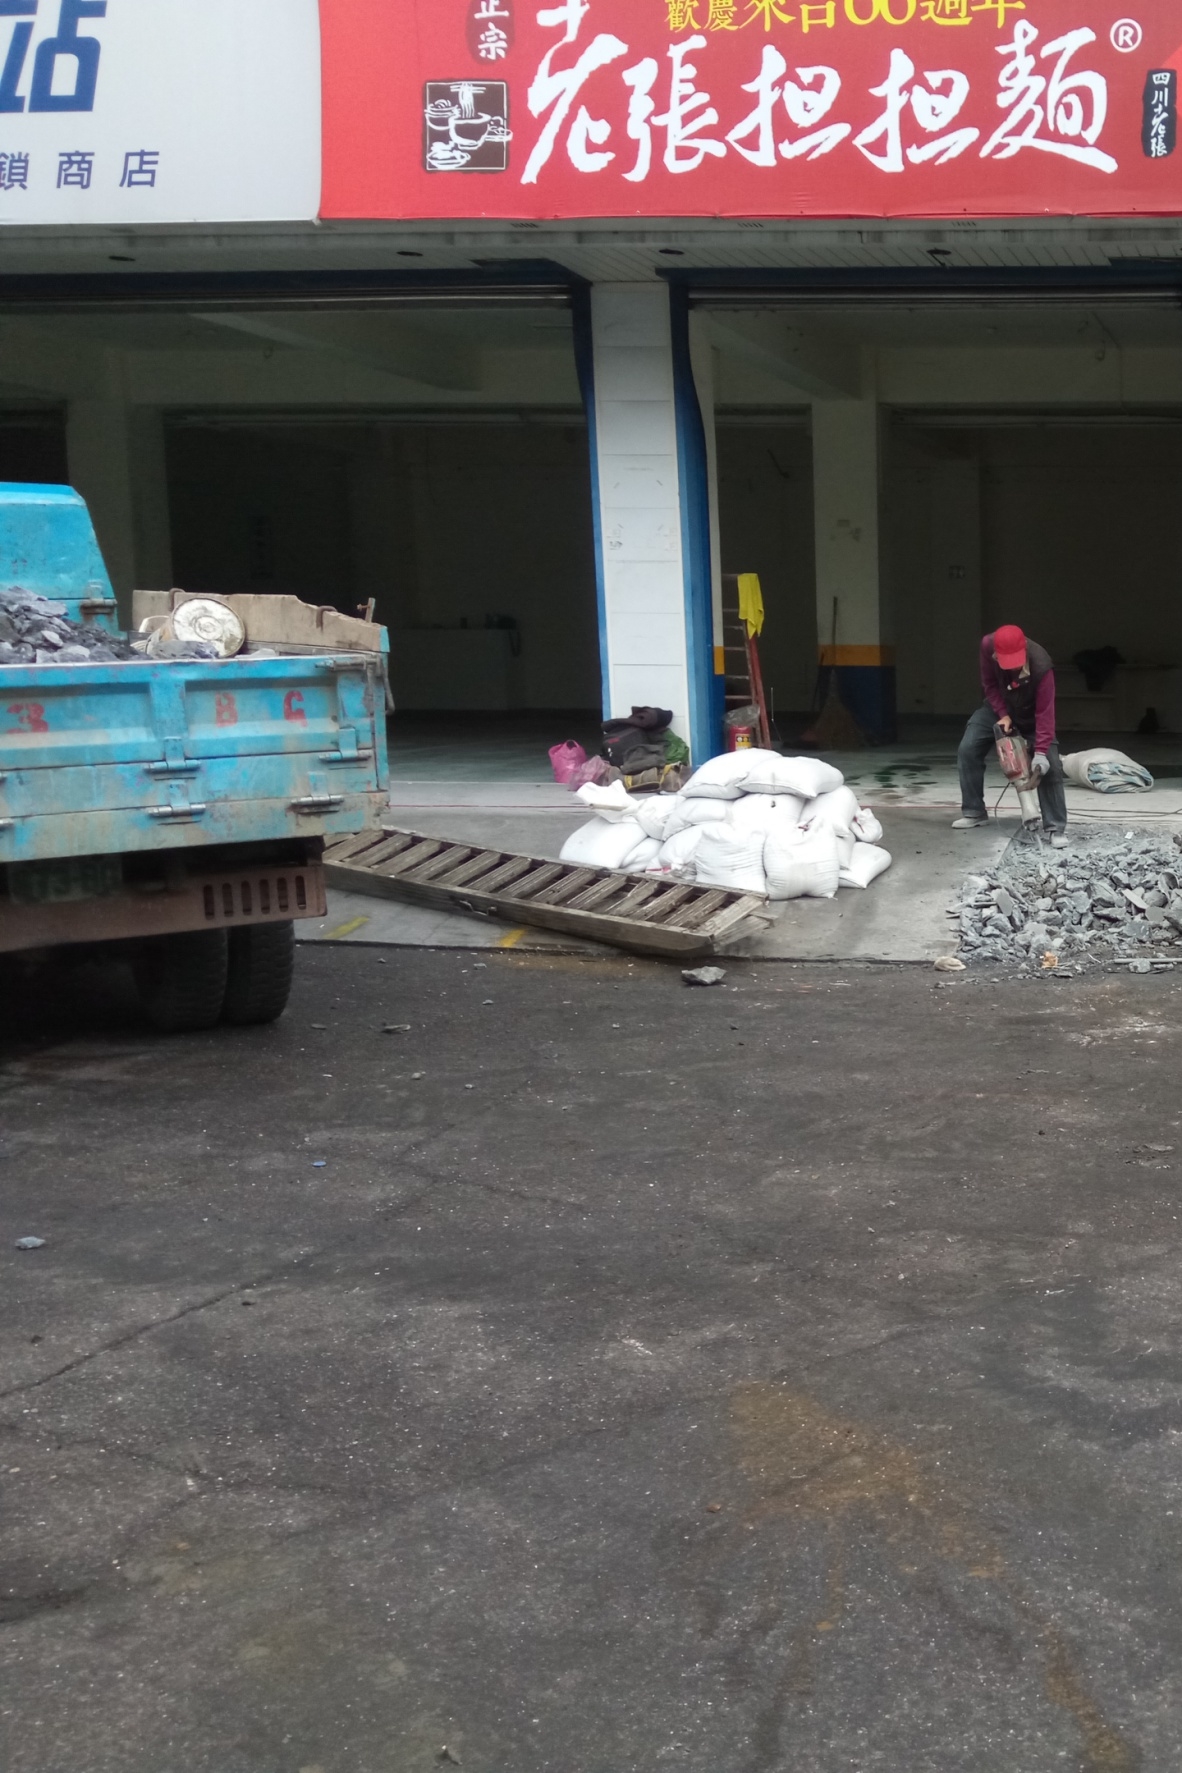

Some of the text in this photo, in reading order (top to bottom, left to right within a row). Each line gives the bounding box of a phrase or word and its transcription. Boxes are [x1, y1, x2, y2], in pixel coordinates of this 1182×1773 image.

[1151, 72, 1171, 158] 四川老張
[0, 149, 160, 190] 鎖商店
